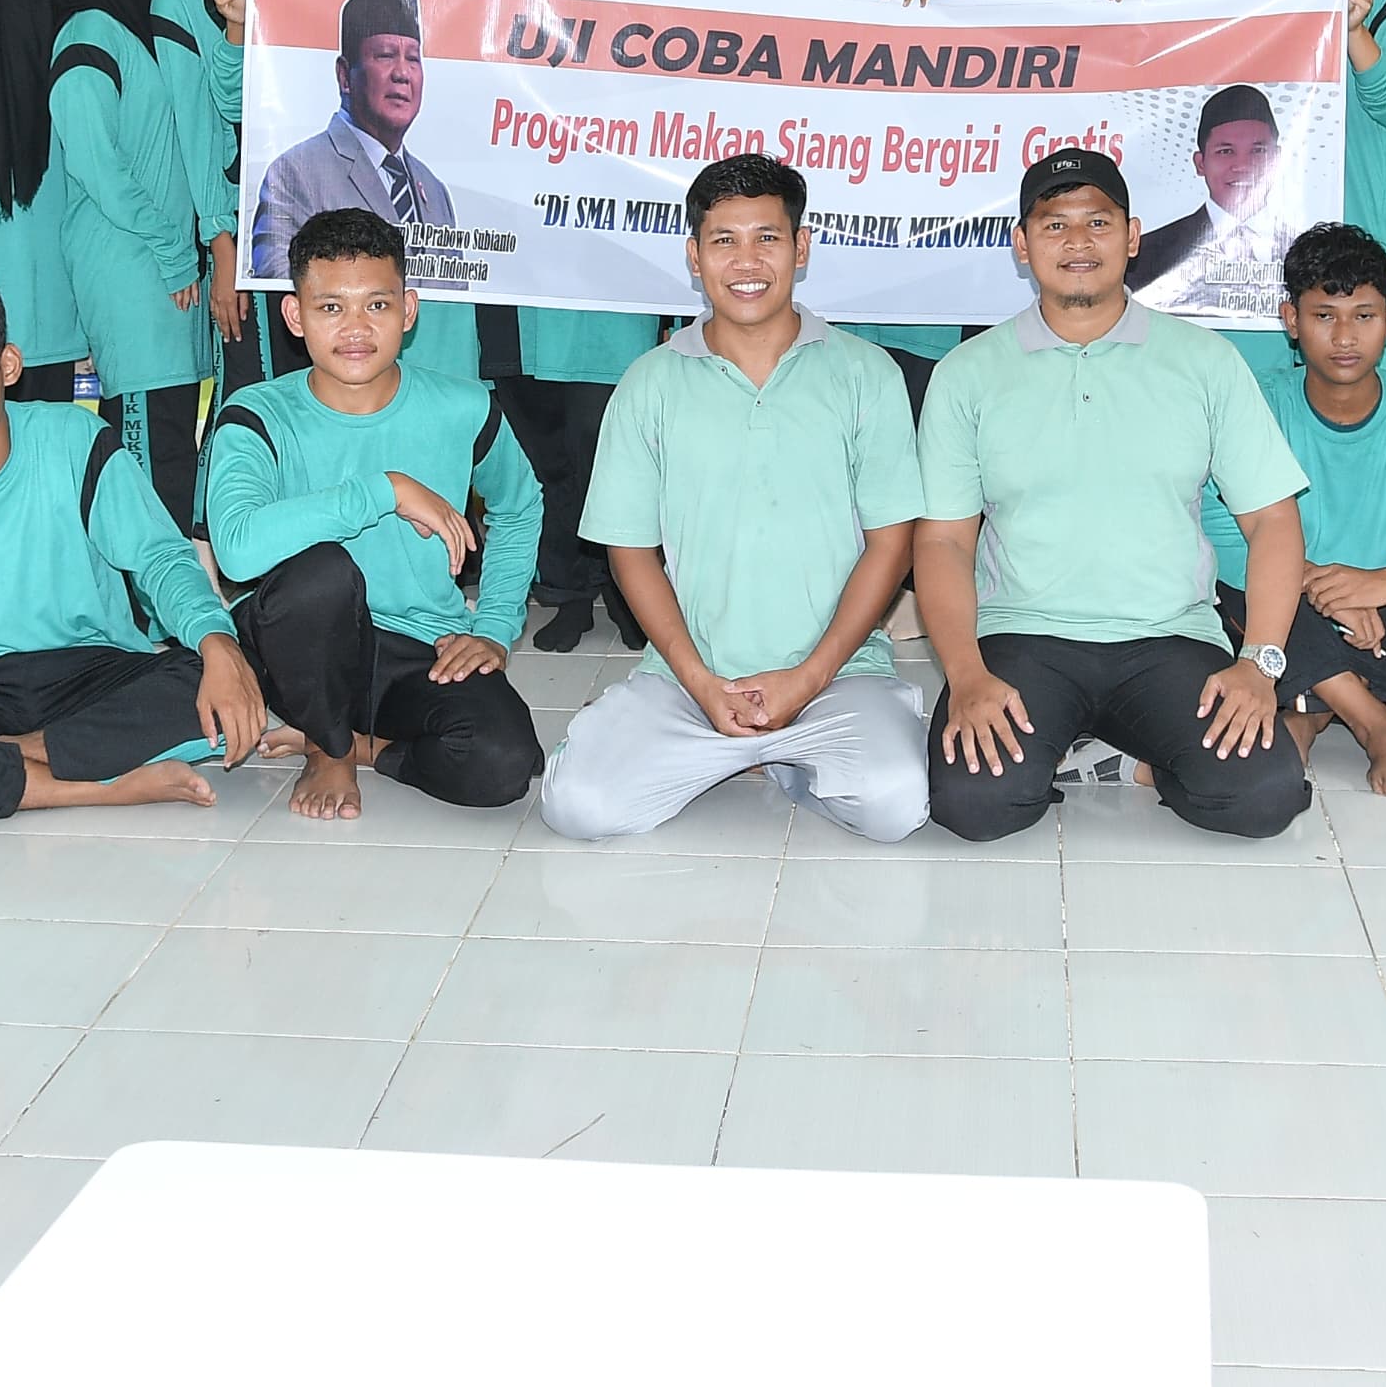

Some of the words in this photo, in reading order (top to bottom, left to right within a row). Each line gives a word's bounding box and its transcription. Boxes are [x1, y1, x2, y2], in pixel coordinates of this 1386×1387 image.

[507, 13, 596, 69] UJI
[610, 23, 783, 80] COBA
[802, 39, 1081, 88] MANDIRI
[491, 99, 639, 163] Program
[649, 111, 765, 161] Makan
[777, 118, 872, 185] Siang
[881, 125, 1001, 187] Bergizi
[413, 224, 422, 246] H.
[425, 225, 470, 249] Prabowo
[473, 229, 516, 253] Subianto
[574, 197, 616, 231] SMA
[808, 212, 902, 248] PENARIK
[439, 256, 489, 281] Indonesia
